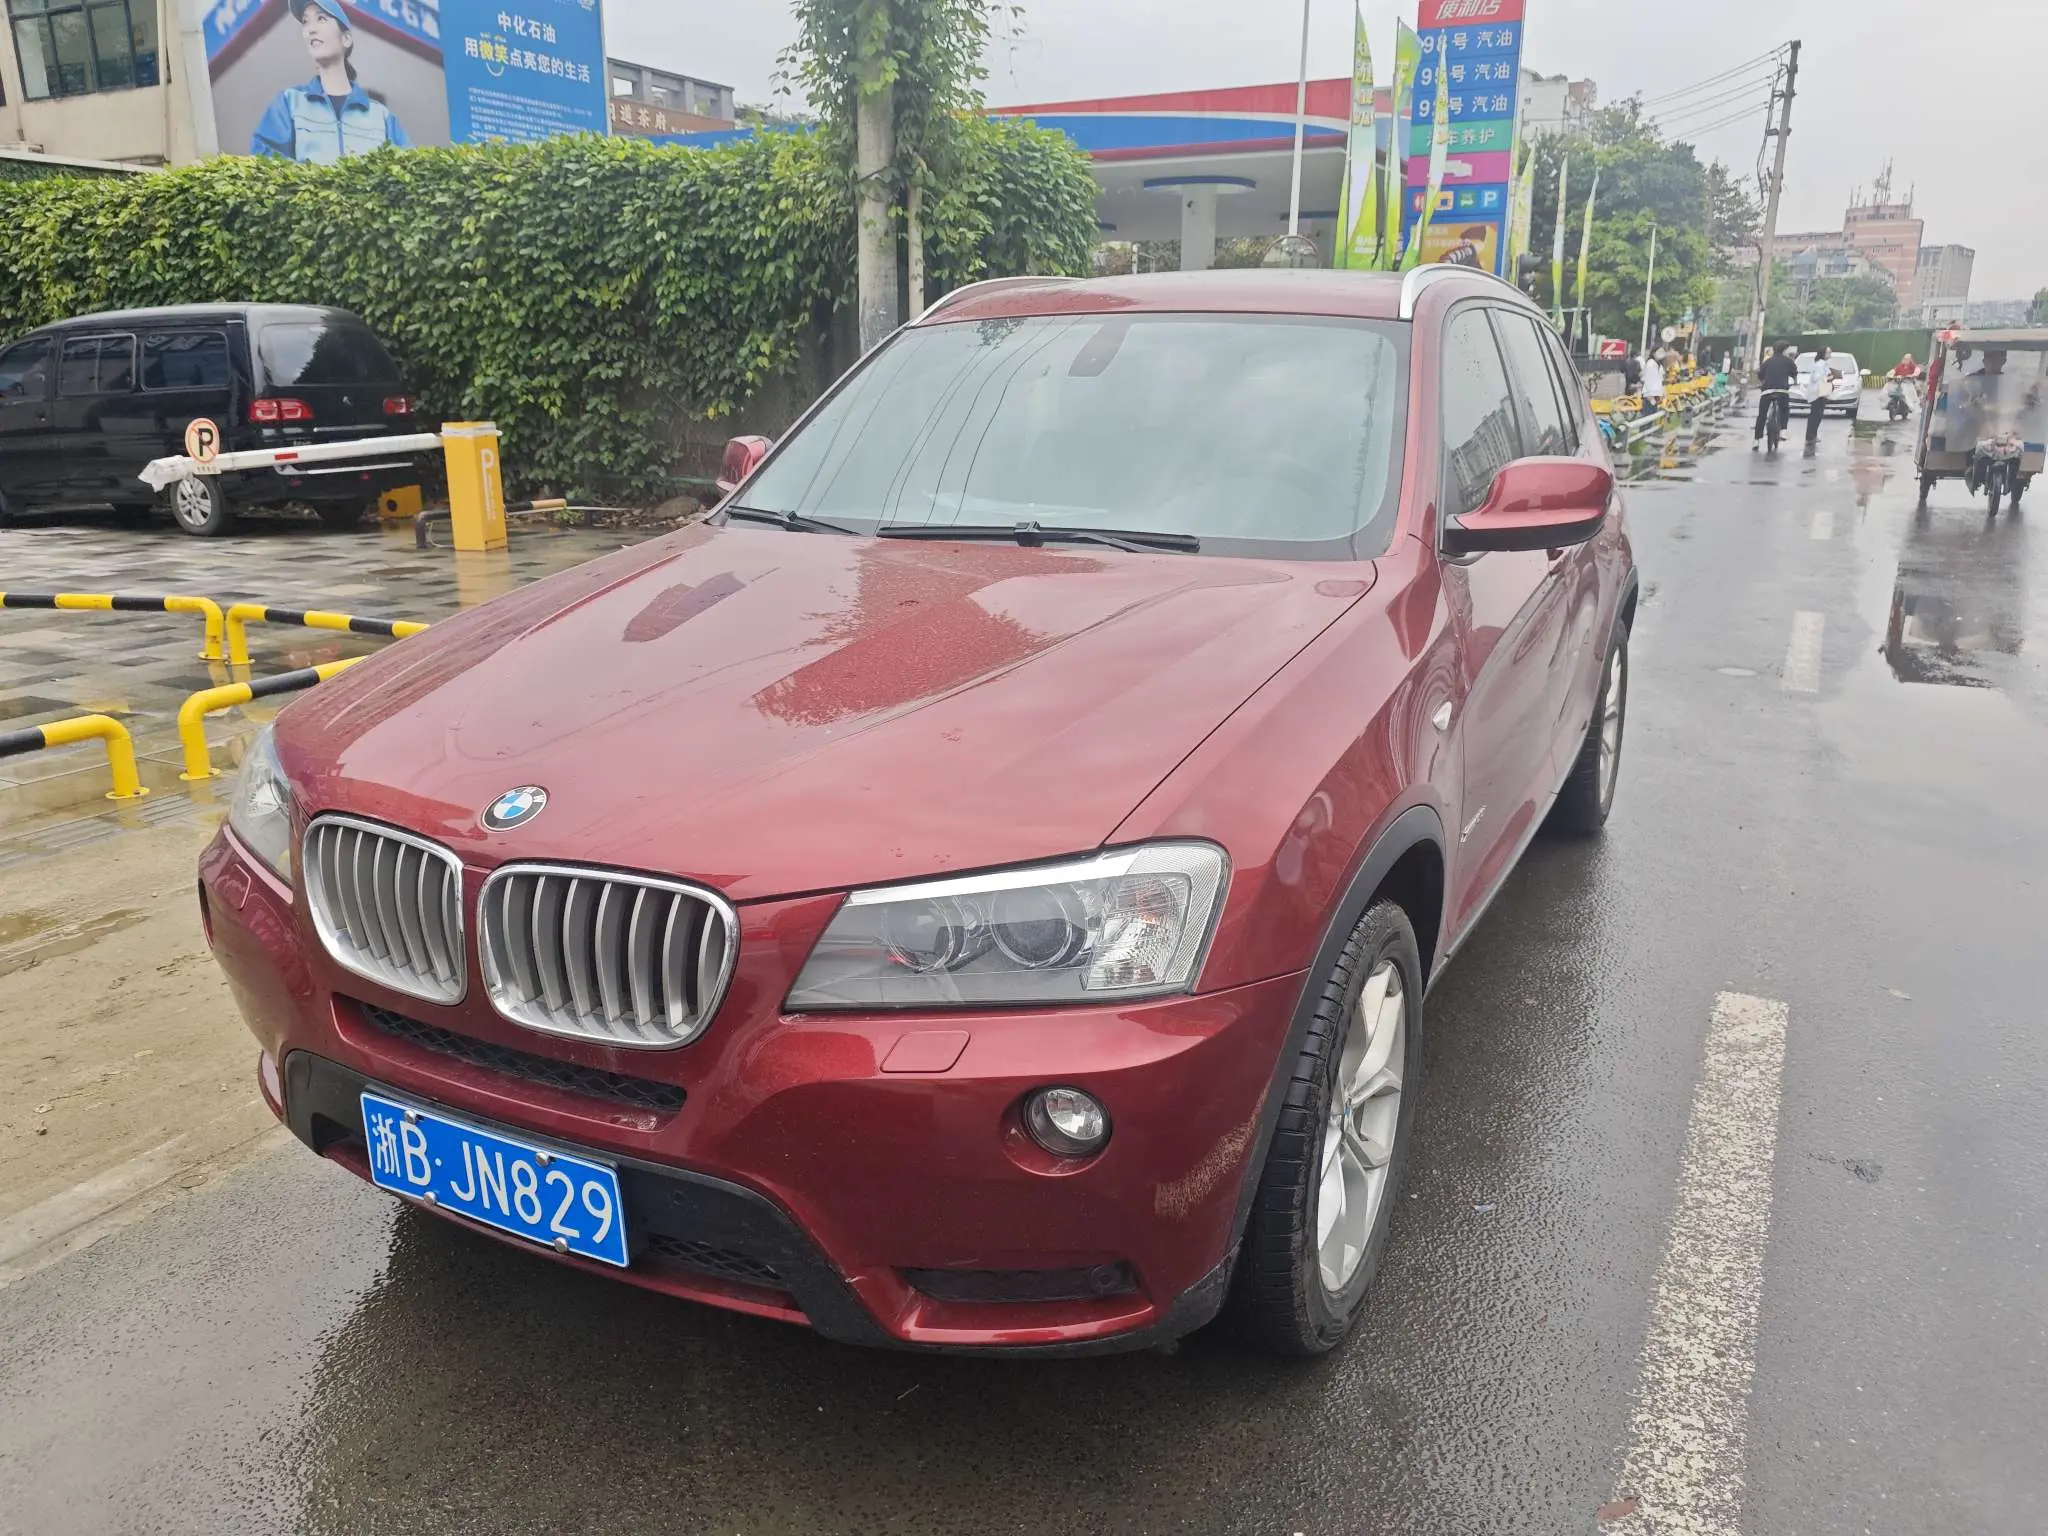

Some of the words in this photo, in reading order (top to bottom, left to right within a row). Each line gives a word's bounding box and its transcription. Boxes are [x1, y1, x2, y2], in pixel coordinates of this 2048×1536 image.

[1436, 0, 1501, 19] 便利店
[497, 10, 557, 44] 中化石油
[1476, 29, 1513, 49] 汽油
[464, 36, 591, 84] 用微笑点亮您的生活
[1420, 63, 1466, 86] 9号
[1474, 61, 1511, 81] 汽油
[1419, 96, 1463, 117] 9号
[1471, 93, 1508, 113] 汽油
[1426, 126, 1495, 147] 车养护
